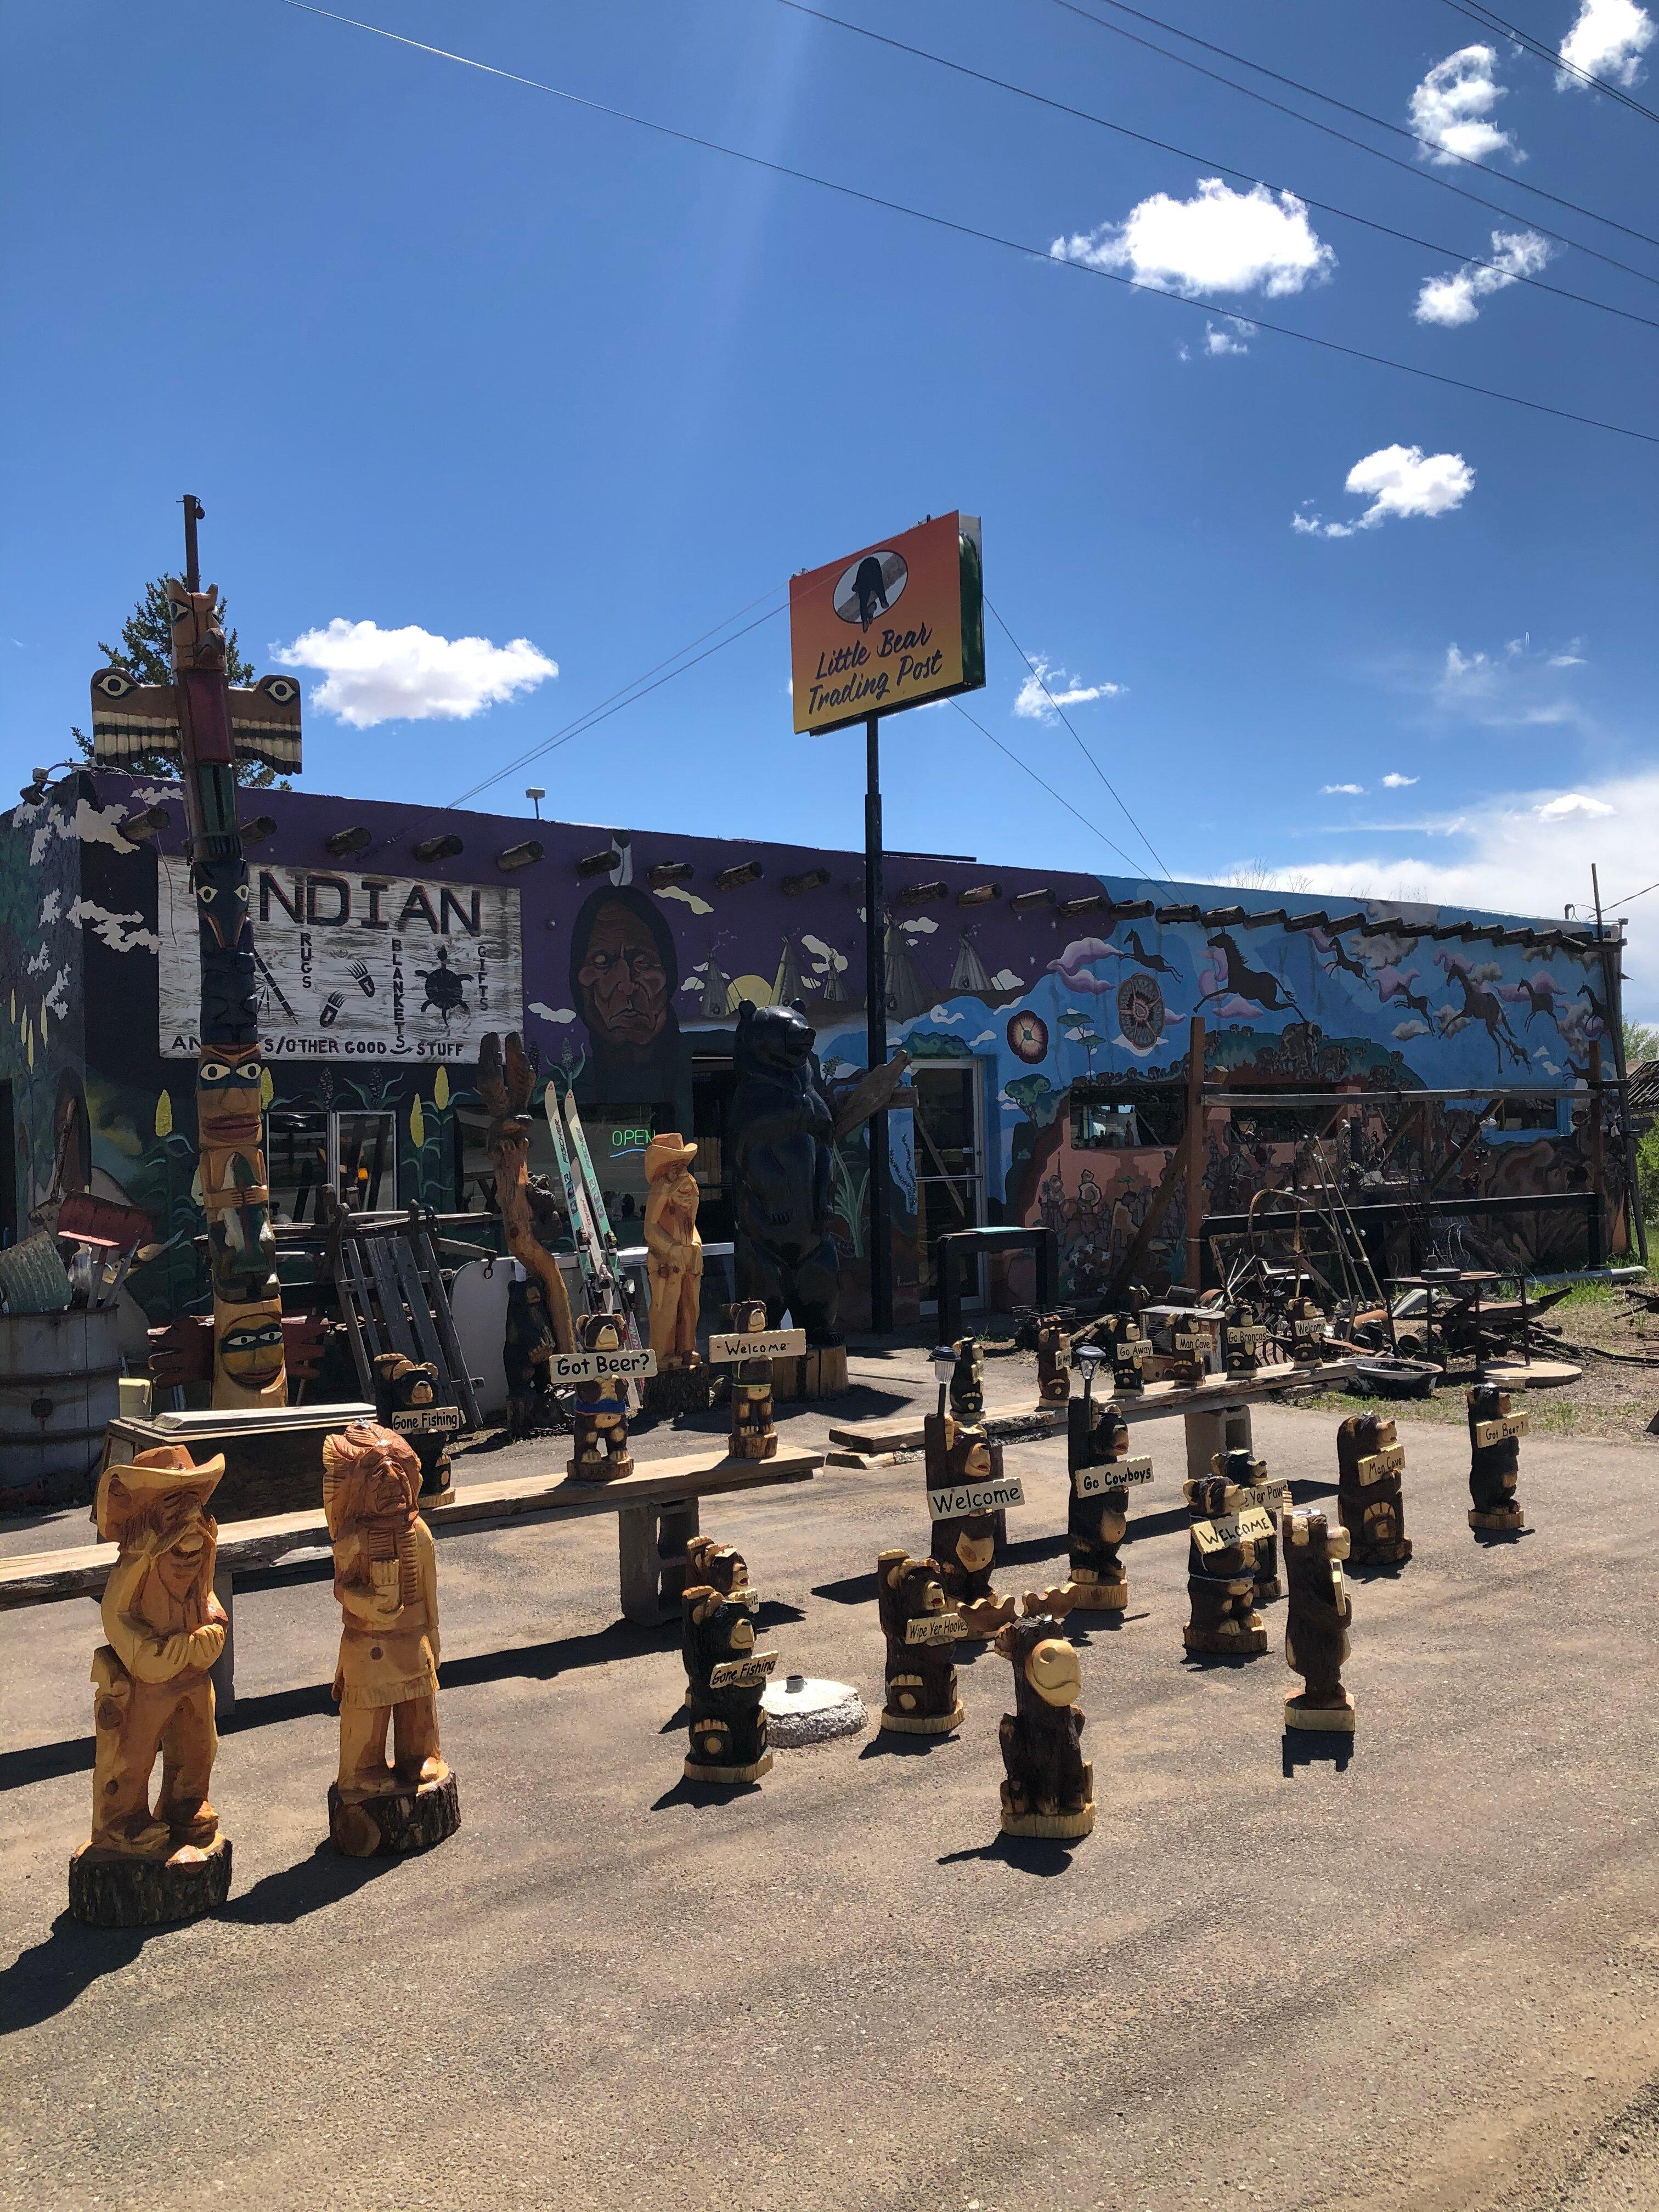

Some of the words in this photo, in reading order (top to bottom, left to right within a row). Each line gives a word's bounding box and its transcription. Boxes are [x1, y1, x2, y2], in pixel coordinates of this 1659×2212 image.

[815, 640, 871, 680] Little
[877, 622, 933, 657] Bear
[809, 672, 890, 715] Trading
[897, 649, 943, 687] Post
[258, 870, 481, 938] NDIAN
[300, 933, 313, 989] RUGS
[477, 946, 488, 1012] GIFTS
[392, 938, 405, 1047] BLANKETS
[345, 1041, 386, 1054] GOOD
[416, 1042, 464, 1057] STUFF
[554, 1119, 568, 1164] FISCHER
[612, 1130, 656, 1146] OPEN
[1228, 1332, 1238, 1343] Go
[1297, 1322, 1326, 1335] Welcome
[724, 1339, 787, 1356] Welcome
[1120, 1346, 1130, 1357] Go
[1133, 1346, 1152, 1357] Away
[1180, 1339, 1193, 1348] Man
[1195, 1339, 1210, 1349] Cave
[557, 1357, 591, 1376] Got
[596, 1353, 650, 1373] Beer?
[393, 1415, 419, 1430] Gone
[421, 1411, 457, 1429] Fishing
[1486, 1428, 1499, 1441] Got
[1502, 1421, 1524, 1437] Beer?
[1369, 1462, 1385, 1479] Man
[1387, 1456, 1402, 1470] Cave
[1084, 1475, 1099, 1491] Go
[1104, 1468, 1152, 1486] Cowboys
[933, 1487, 1021, 1514] Welcome
[1249, 1490, 1266, 1505] Yer
[1199, 1517, 1270, 1545] WELCOME
[910, 1624, 927, 1639] Wipe
[928, 1622, 943, 1637] Yer
[944, 1620, 968, 1634] Hooves
[713, 1668, 737, 1686] Gone
[741, 1659, 775, 1678] Fishing
